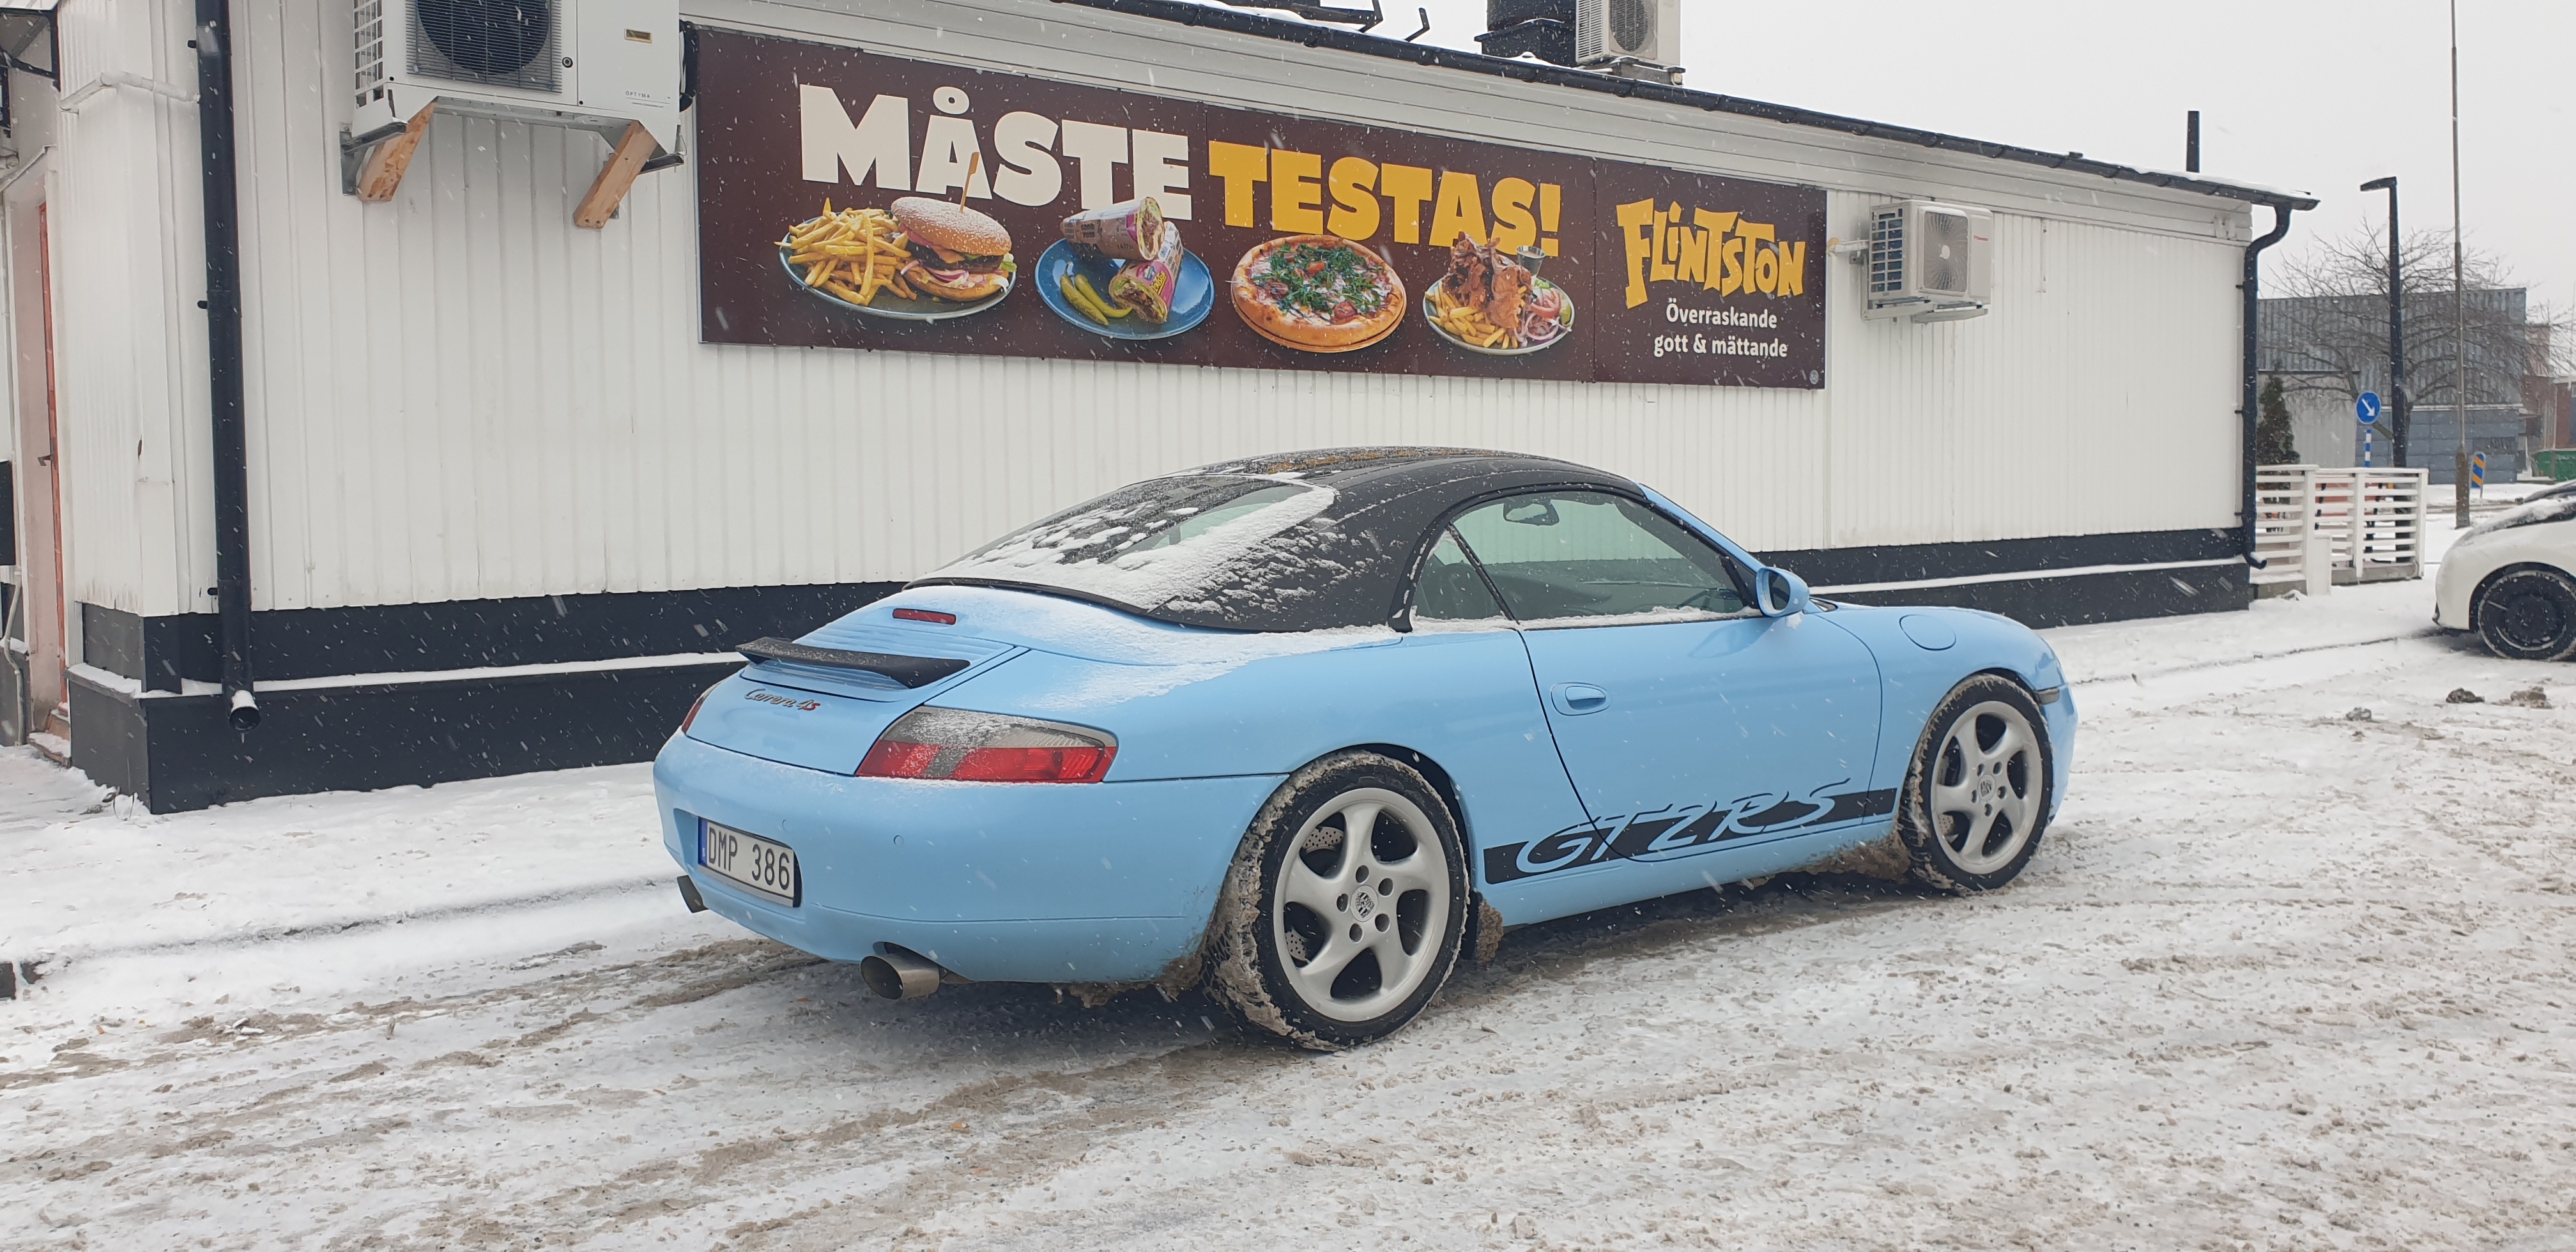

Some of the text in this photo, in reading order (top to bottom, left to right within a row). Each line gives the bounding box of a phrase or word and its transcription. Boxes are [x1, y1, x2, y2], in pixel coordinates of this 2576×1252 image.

[800, 86, 1561, 257] MÅSTE TESTAS!
[1666, 298, 1777, 328] Överraskande
[1653, 333, 1788, 358] gott & mättande
[744, 688, 797, 708] Carrera
[709, 827, 790, 890] DMP 386
